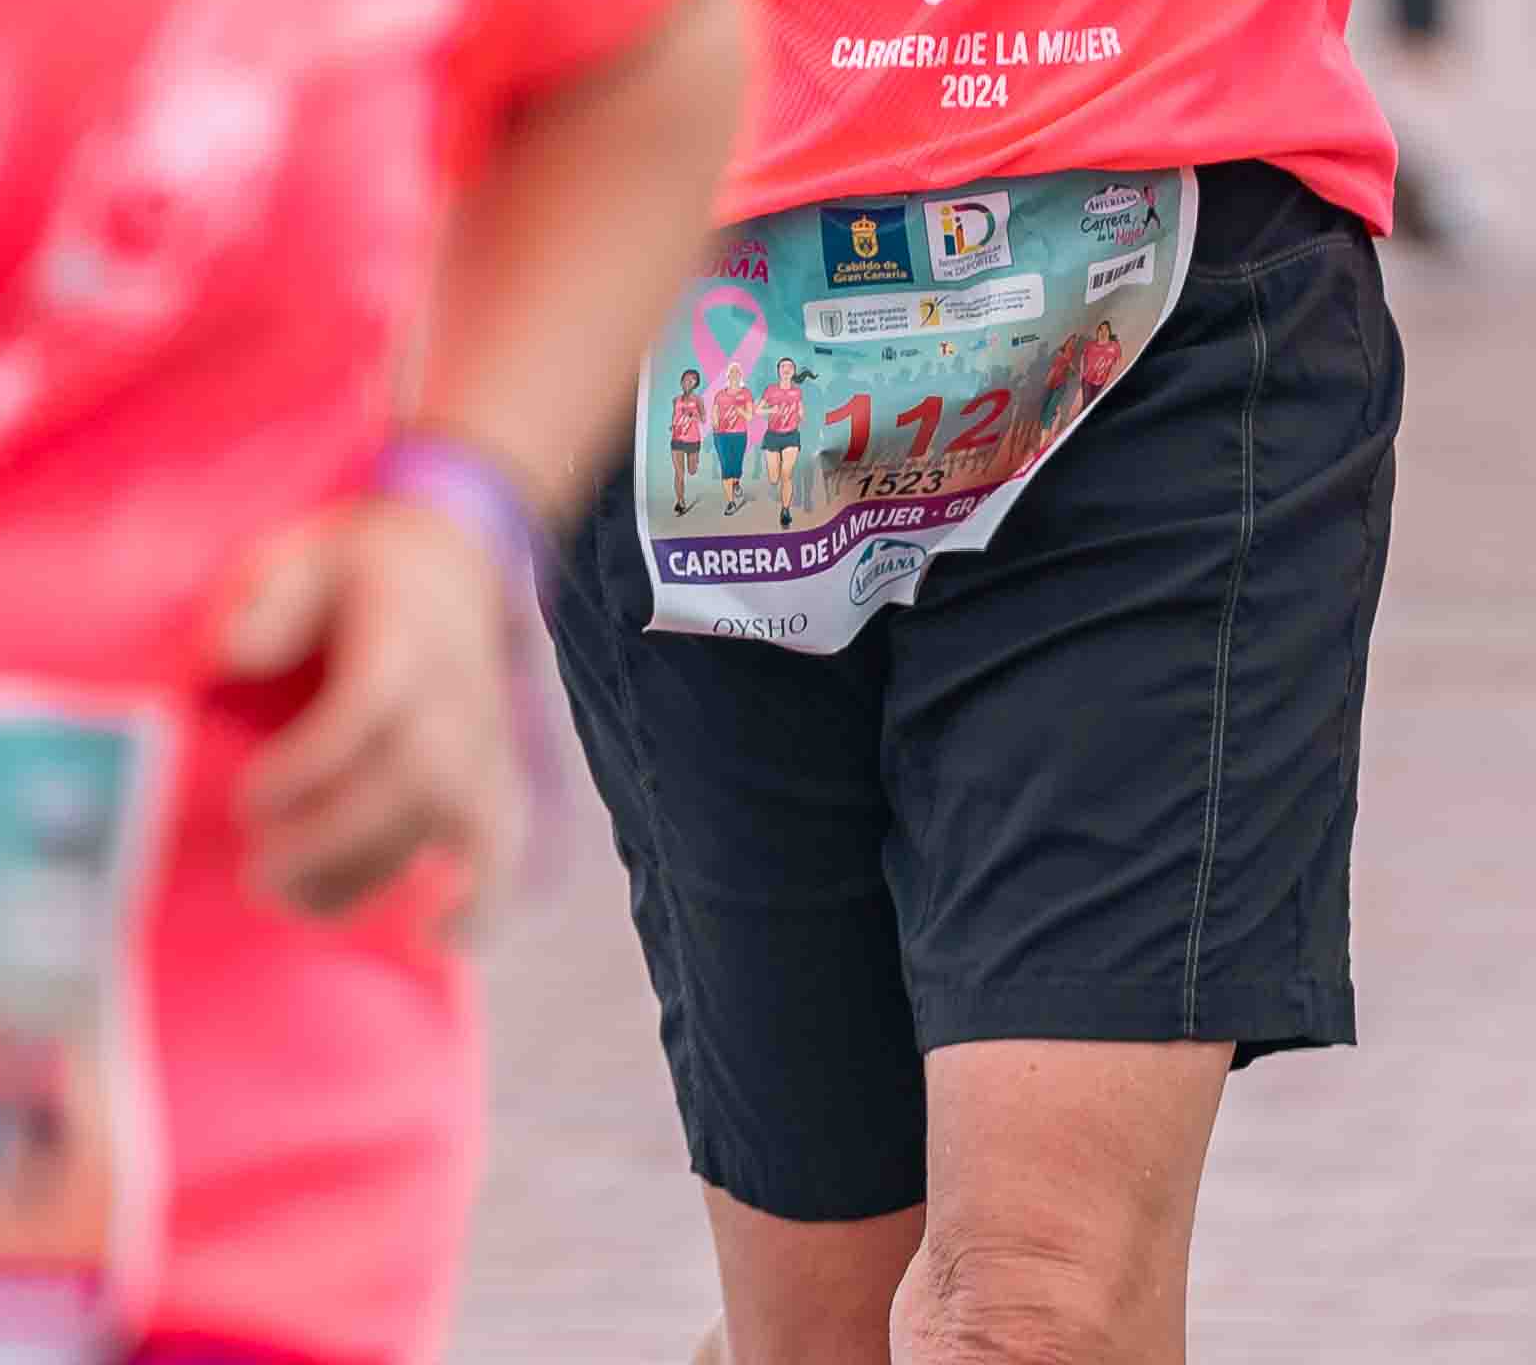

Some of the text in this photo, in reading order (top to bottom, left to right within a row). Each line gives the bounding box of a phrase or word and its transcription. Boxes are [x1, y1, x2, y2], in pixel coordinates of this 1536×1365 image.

[831, 26, 1122, 69] CARRERA DE LA MUJER
[940, 74, 1008, 108] 2024
[1081, 212, 1132, 233] Carrera
[826, 388, 1011, 462] 112
[857, 470, 944, 498] 1523
[668, 548, 792, 576] CARRERA
[800, 543, 830, 570] DE
[831, 530, 848, 556] LA
[850, 506, 924, 542] MUJER
